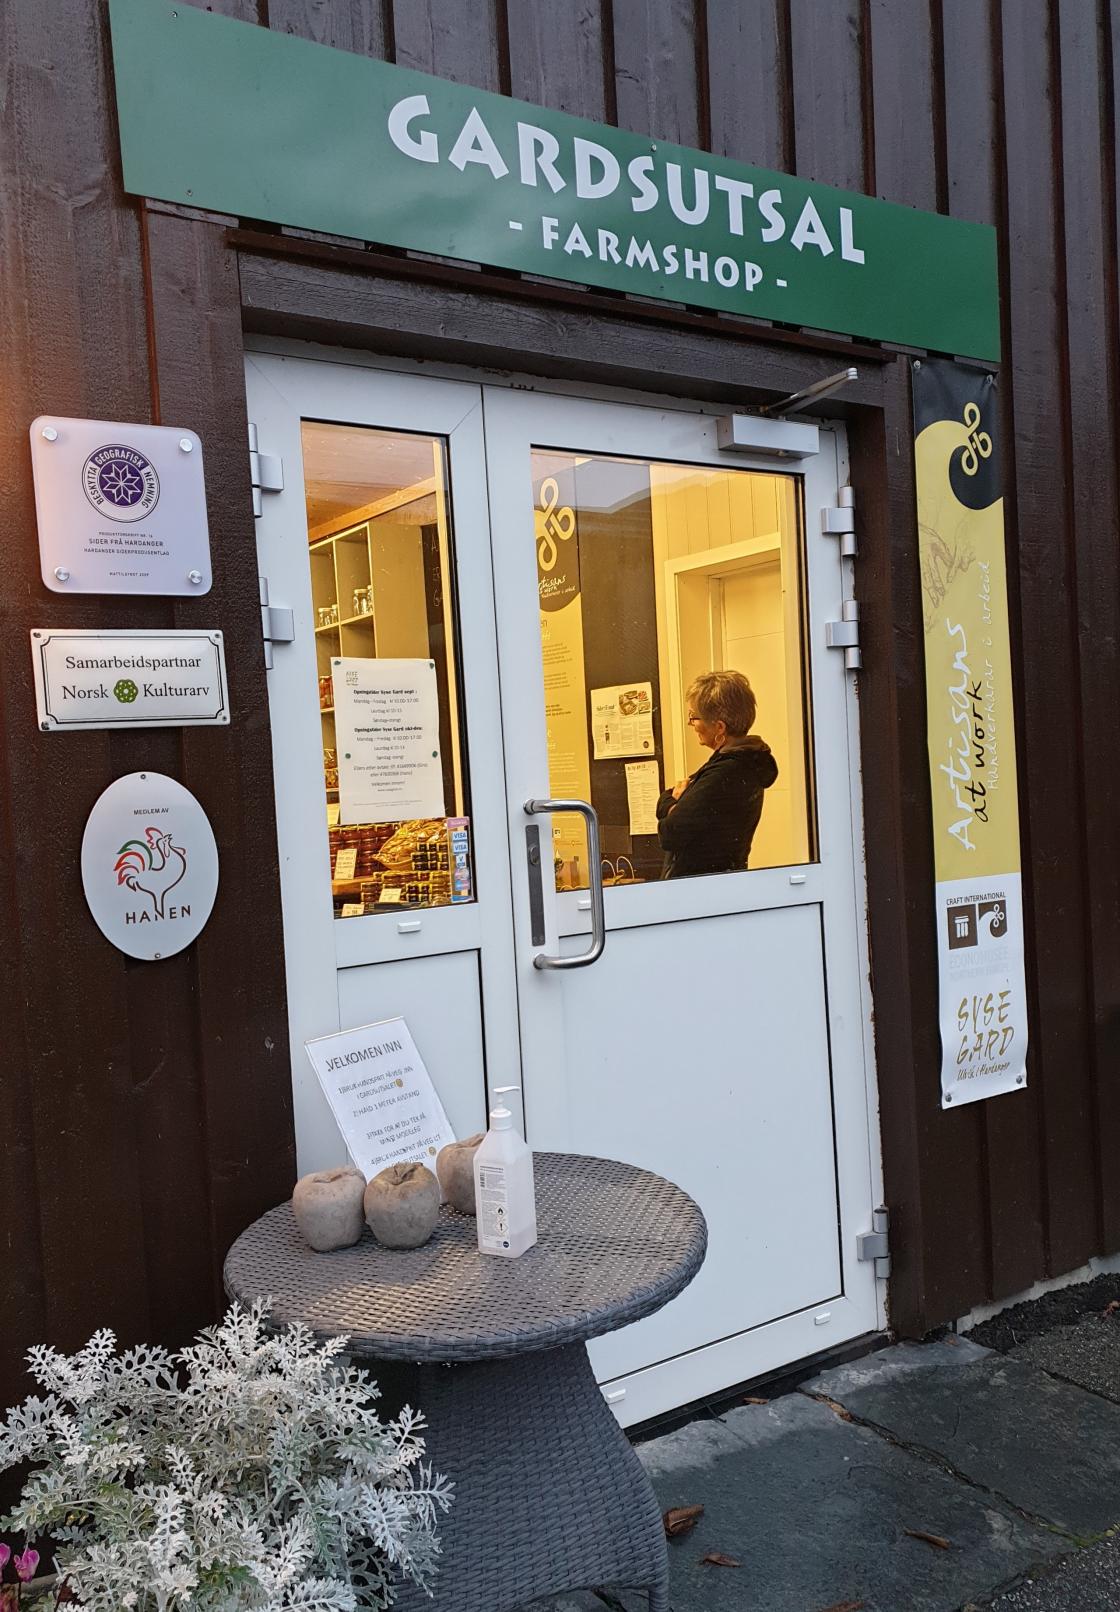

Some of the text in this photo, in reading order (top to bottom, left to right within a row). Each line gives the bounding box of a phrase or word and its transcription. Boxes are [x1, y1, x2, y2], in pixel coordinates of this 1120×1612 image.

[387, 94, 866, 265] GARDSUTSAL
[541, 215, 764, 291] FARMSHOP
[87, 449, 156, 509] BESKYTTA GEOGRAFISK NEMNING
[110, 537, 123, 545] FRÅ
[124, 539, 164, 547] HARDANGER
[65, 655, 202, 671] Samarbeidspartnar
[62, 682, 210, 700] Norsk Kulturarv
[940, 617, 975, 850] Artisans
[965, 681, 989, 823] at work
[126, 905, 191, 925] HANEN
[946, 891, 1006, 906] CRAFT INTERNATIONAL
[957, 989, 1012, 1034] SYSE
[326, 1039, 403, 1071] VELKOMEN INN
[956, 1026, 1015, 1065] GARD
